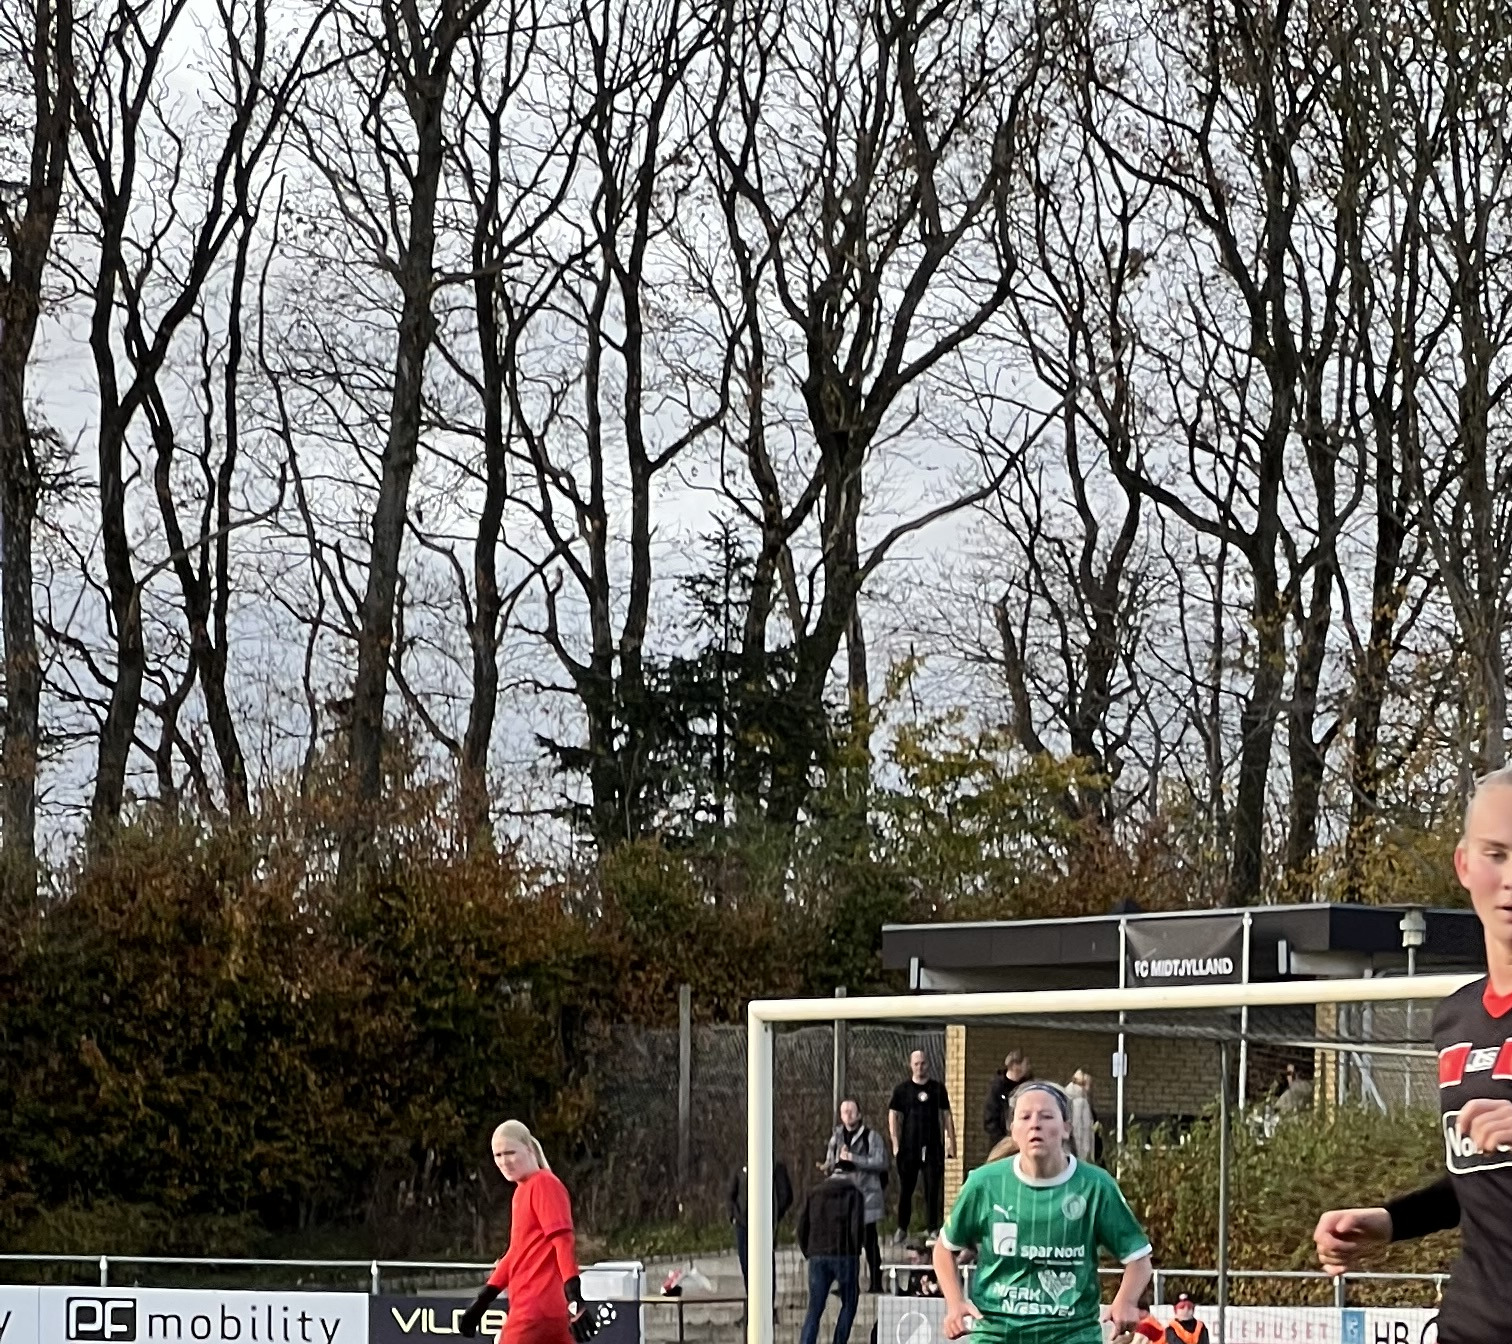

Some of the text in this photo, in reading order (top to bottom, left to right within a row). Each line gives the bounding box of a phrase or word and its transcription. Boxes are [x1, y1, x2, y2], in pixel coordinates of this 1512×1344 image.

[1134, 957, 1234, 978] FC MIDTJYLLAND
[69, 1299, 135, 1340] PF
